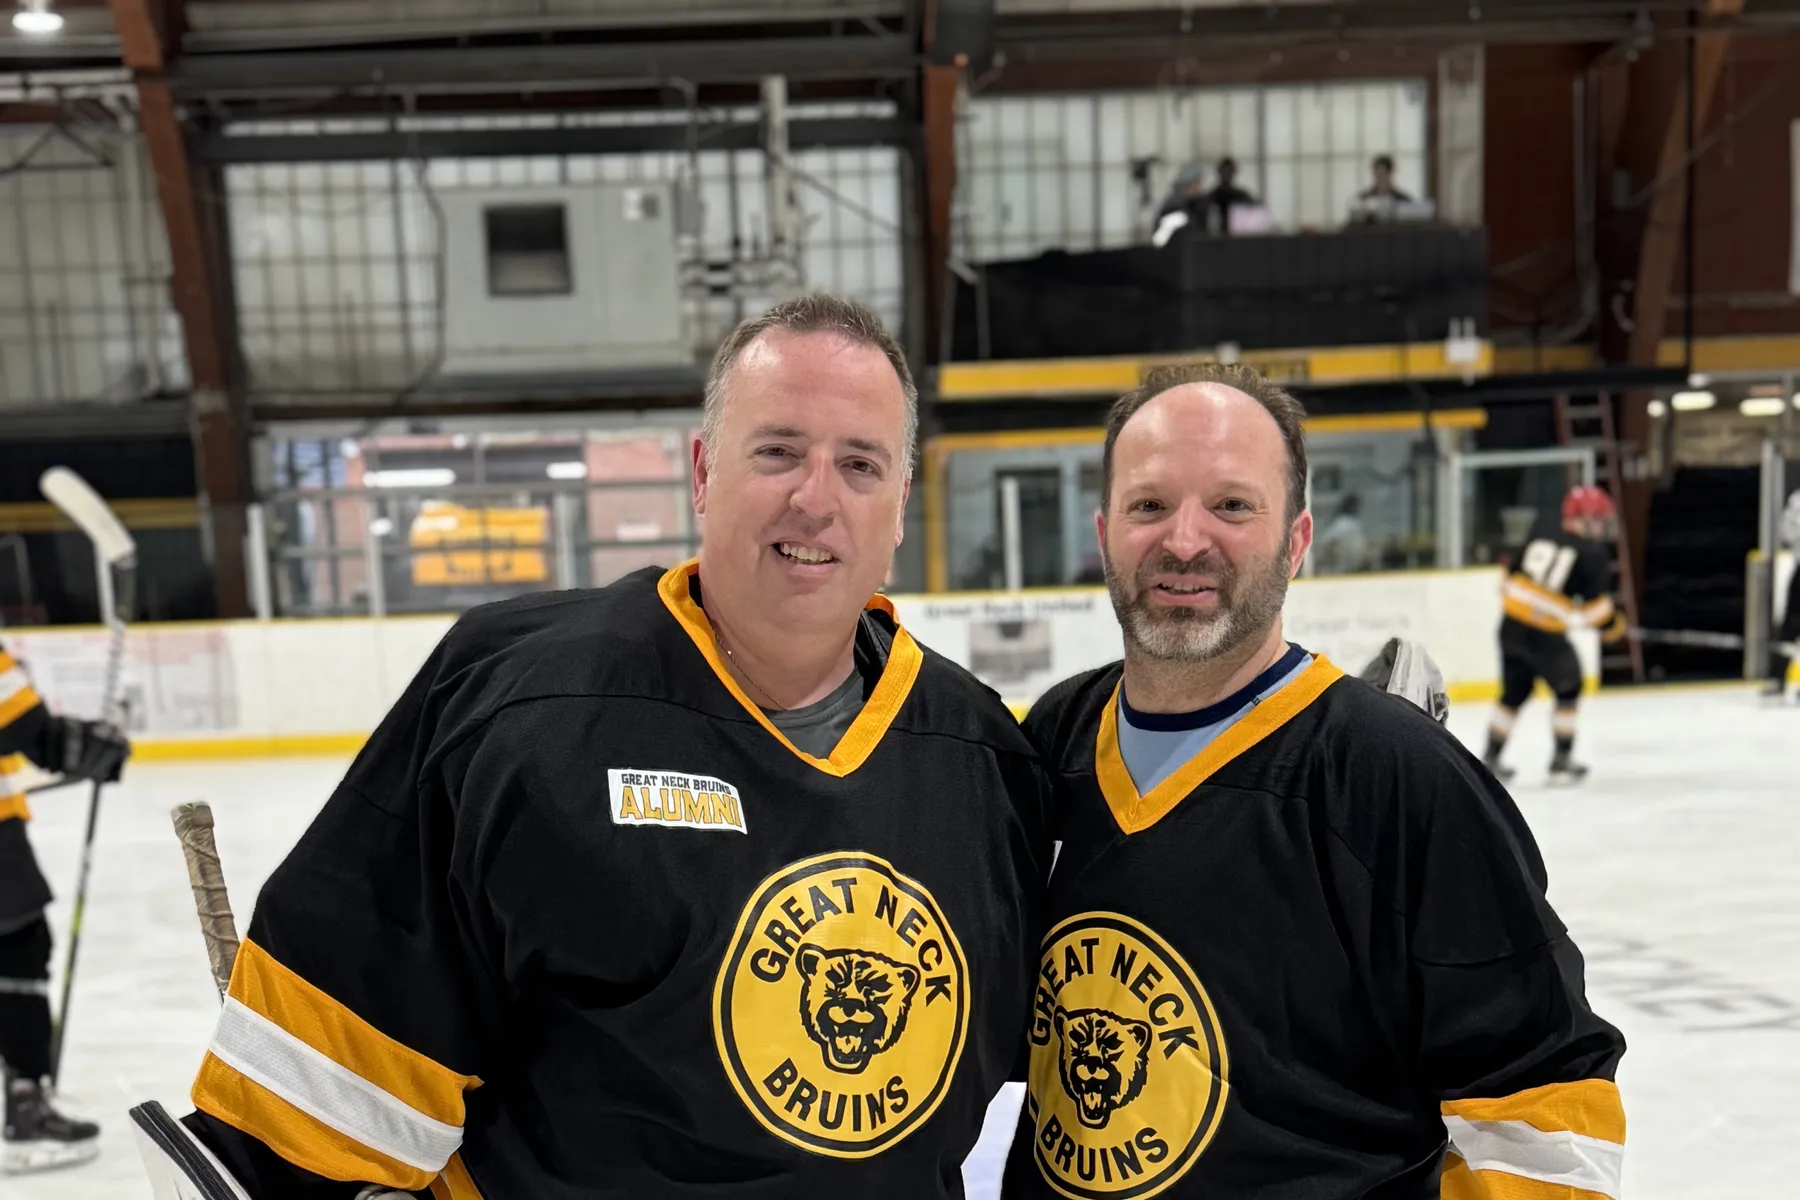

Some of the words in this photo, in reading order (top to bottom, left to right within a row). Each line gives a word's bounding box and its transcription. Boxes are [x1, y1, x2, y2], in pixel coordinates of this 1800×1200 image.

[620, 785, 742, 828] ALUMNI
[621, 773, 658, 786] GREAT
[661, 775, 691, 790] NECK
[693, 779, 731, 795] BRUINS
[750, 877, 858, 983] GREAT
[875, 884, 952, 1008] NECK
[1030, 937, 1100, 1047] GREAT
[1110, 942, 1200, 1060] NECK
[763, 1057, 909, 1132] BRUINS
[1040, 1113, 1169, 1183] BRUINS
